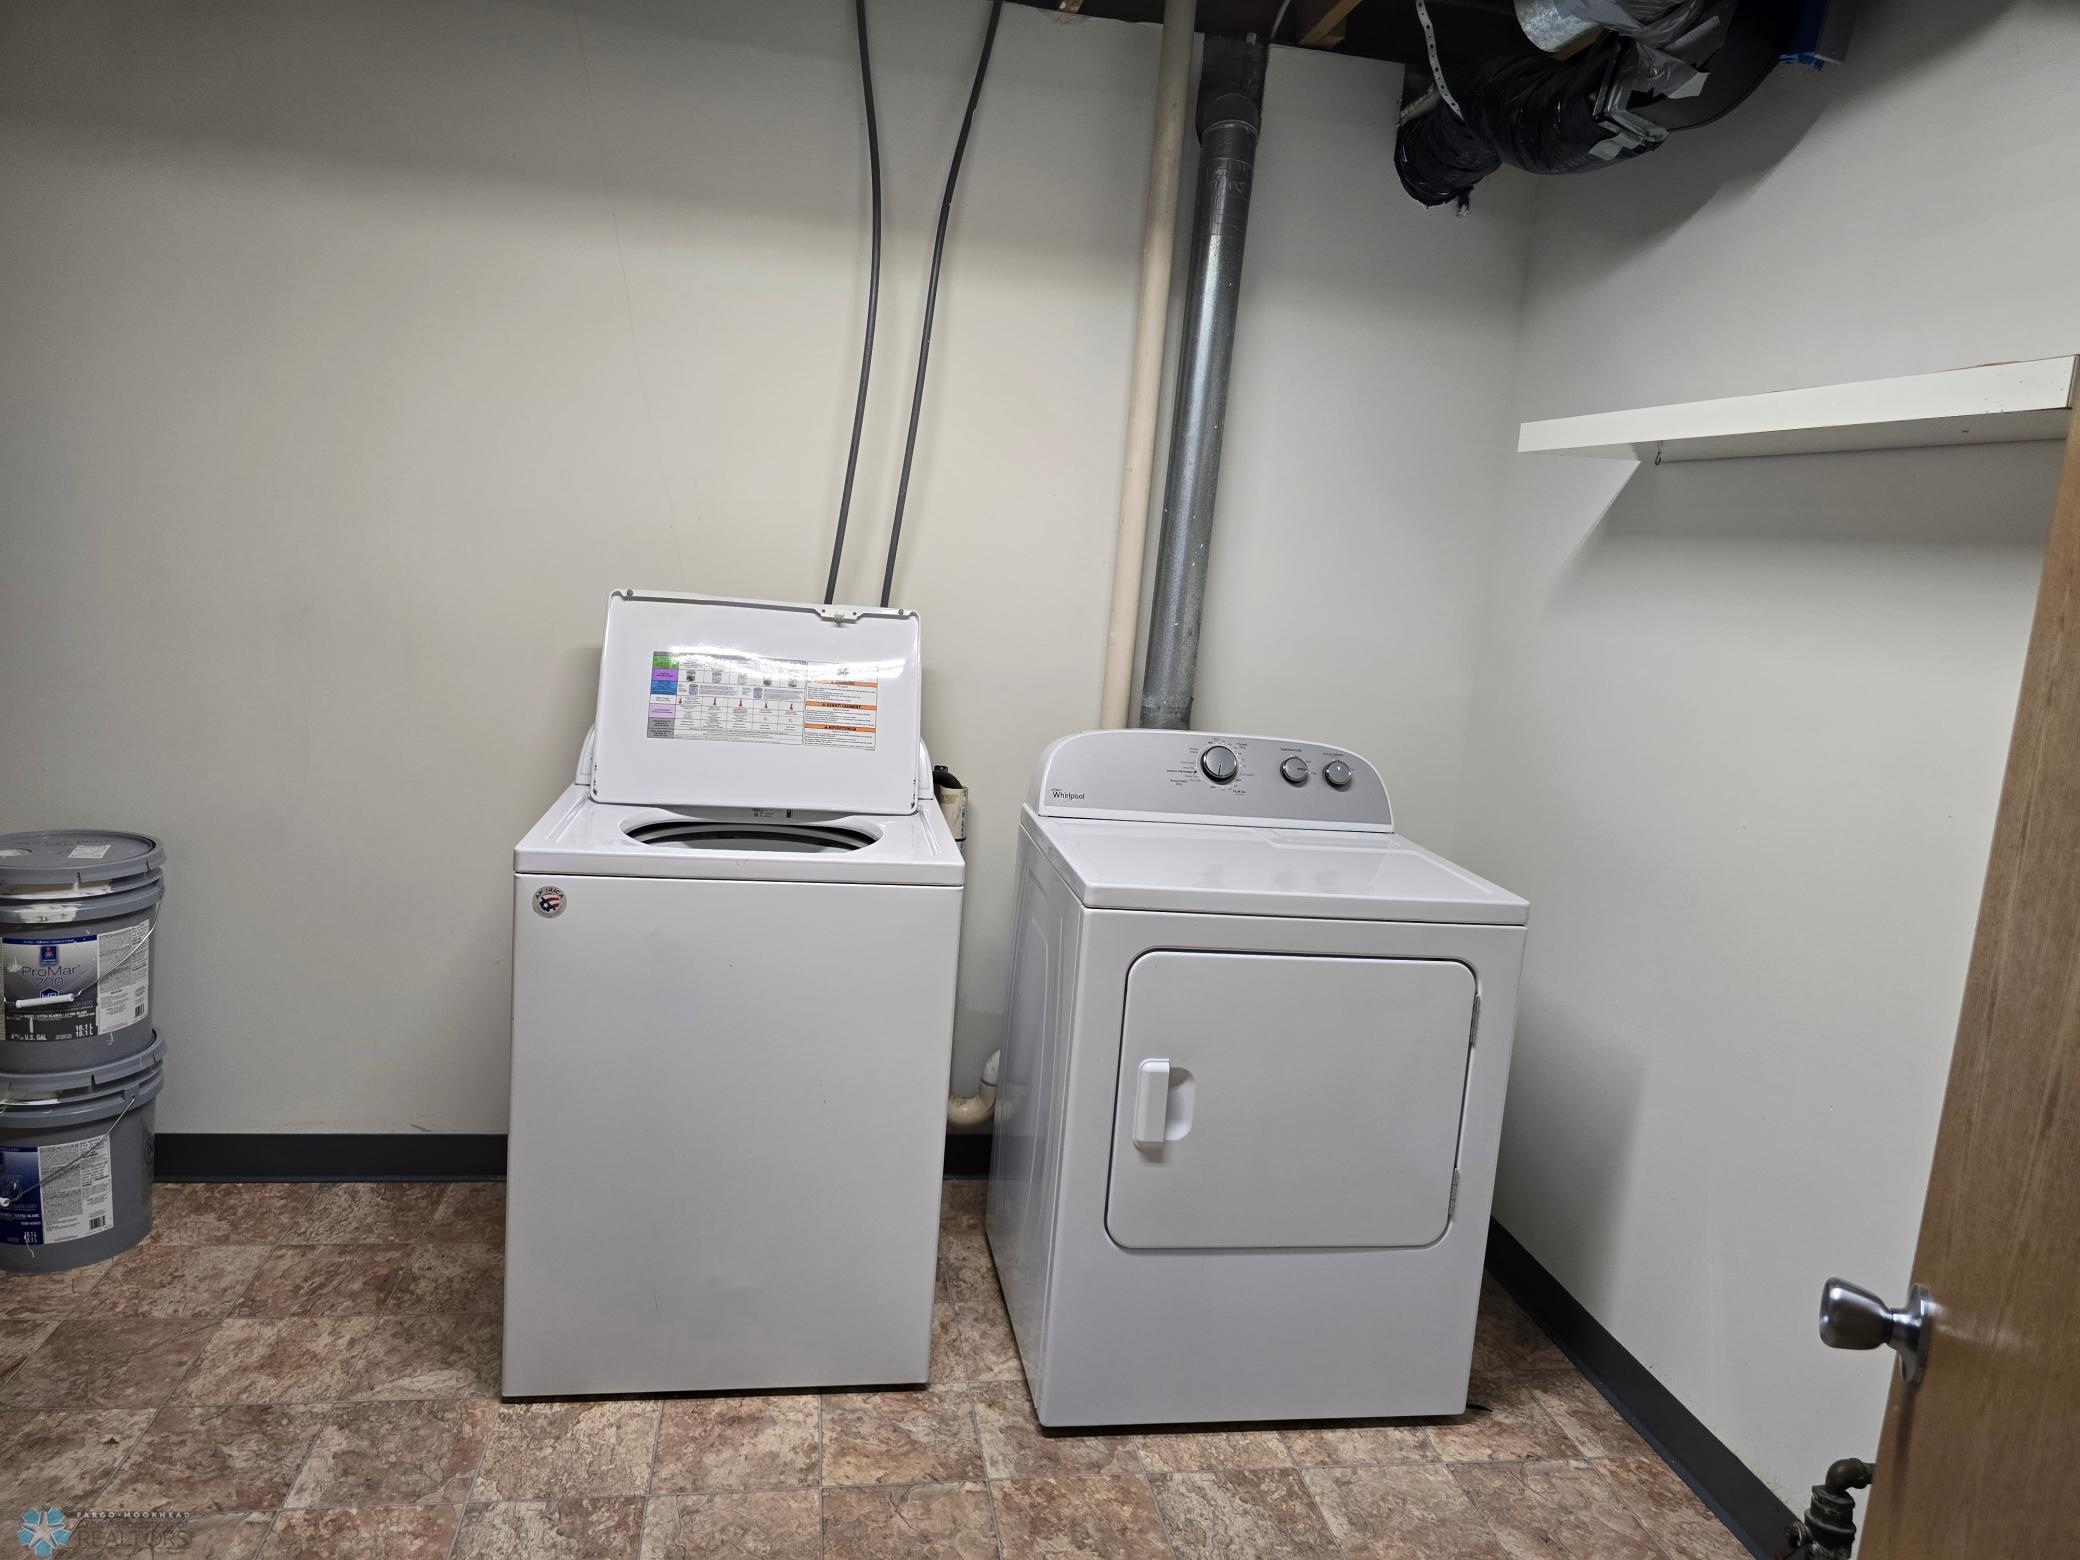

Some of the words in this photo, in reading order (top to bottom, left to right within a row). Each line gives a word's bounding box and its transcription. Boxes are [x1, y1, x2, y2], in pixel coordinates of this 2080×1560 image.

[1052, 791, 1085, 800] Whirlpool
[21, 965, 78, 977] ProMar
[35, 977, 63, 987] 200
